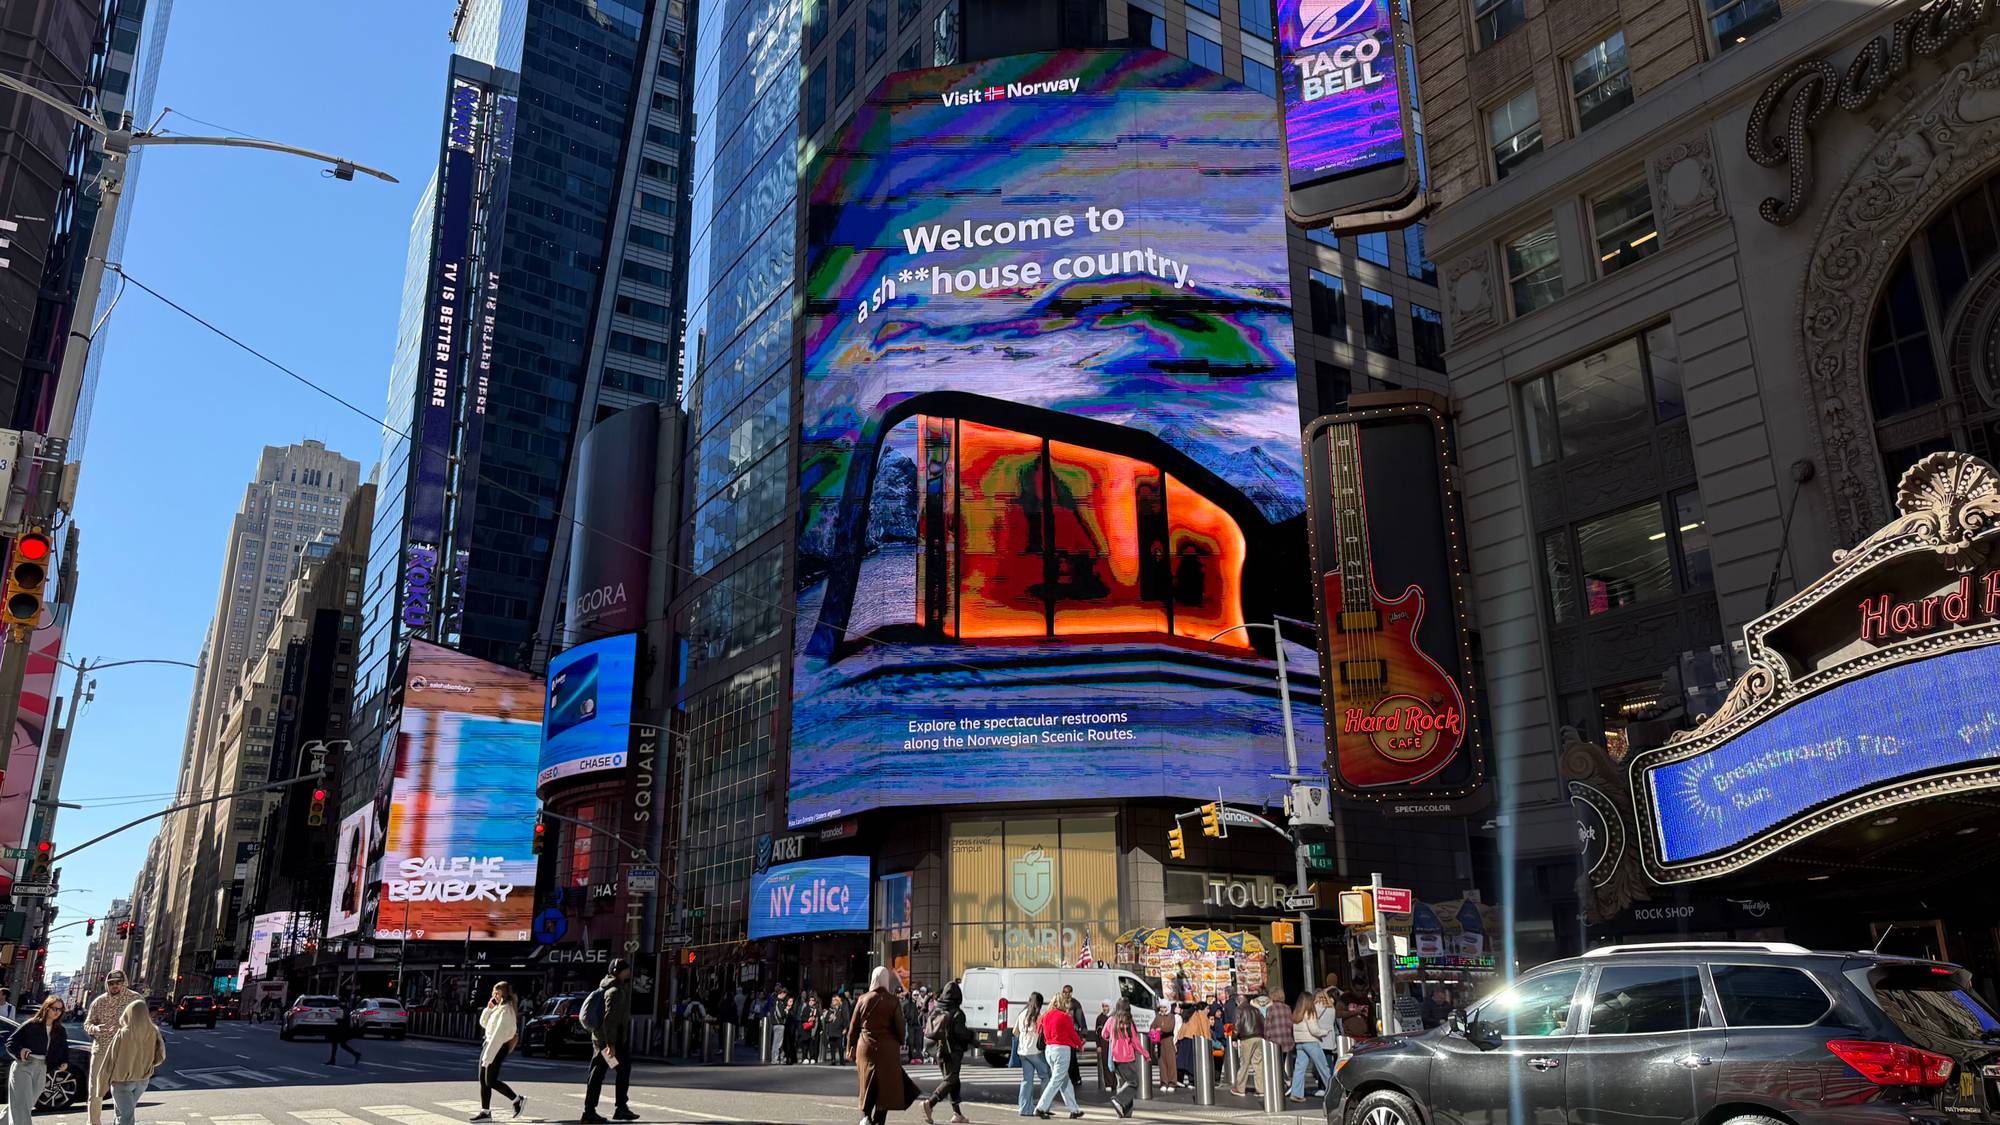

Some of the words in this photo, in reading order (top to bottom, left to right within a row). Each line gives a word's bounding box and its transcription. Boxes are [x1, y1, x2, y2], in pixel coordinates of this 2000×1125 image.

[1294, 38, 1380, 79] TACO
[941, 89, 982, 108] Visit
[1007, 77, 1080, 99] Norway
[1303, 62, 1385, 101] BELL
[903, 214, 1075, 255] Welcome
[1085, 206, 1124, 233] to
[444, 263, 457, 282] TV
[442, 286, 455, 301] IS
[857, 298, 868, 323] a
[1053, 247, 1196, 289] country.
[436, 305, 454, 362] BETTER
[432, 367, 448, 408] HERE
[404, 547, 438, 626] ROKU
[1858, 576, 1969, 639] Hard
[908, 720, 956, 734] Explore
[960, 717, 981, 730] the
[984, 714, 1059, 730] spectacular
[1062, 712, 1128, 725] restrooms
[1344, 706, 1402, 733] Hard
[1405, 706, 1461, 736] Rock
[903, 738, 939, 751] along
[943, 736, 964, 748] the
[967, 733, 1038, 747] Norwegian
[1042, 730, 1084, 743] Scenic
[1088, 728, 1137, 741] Routes.
[1388, 737, 1422, 749] CAFE
[580, 756, 611, 770] CHASE
[634, 728, 656, 822] SQUARE
[1394, 804, 1451, 814] SPECTACOLOR
[821, 825, 843, 839] branded
[952, 839, 973, 847] cross
[973, 838, 992, 846] river
[6, 849, 14, 858] W
[771, 835, 806, 862] AT&T
[400, 856, 505, 878] SALEHE
[388, 879, 513, 902] BEMBURY
[770, 884, 795, 919] NY
[800, 878, 850, 915] slice
[1635, 908, 1664, 920] ROCK
[1666, 906, 1695, 919] SHOP
[989, 927, 1077, 949] TOURO
[548, 949, 608, 963] CHASE
